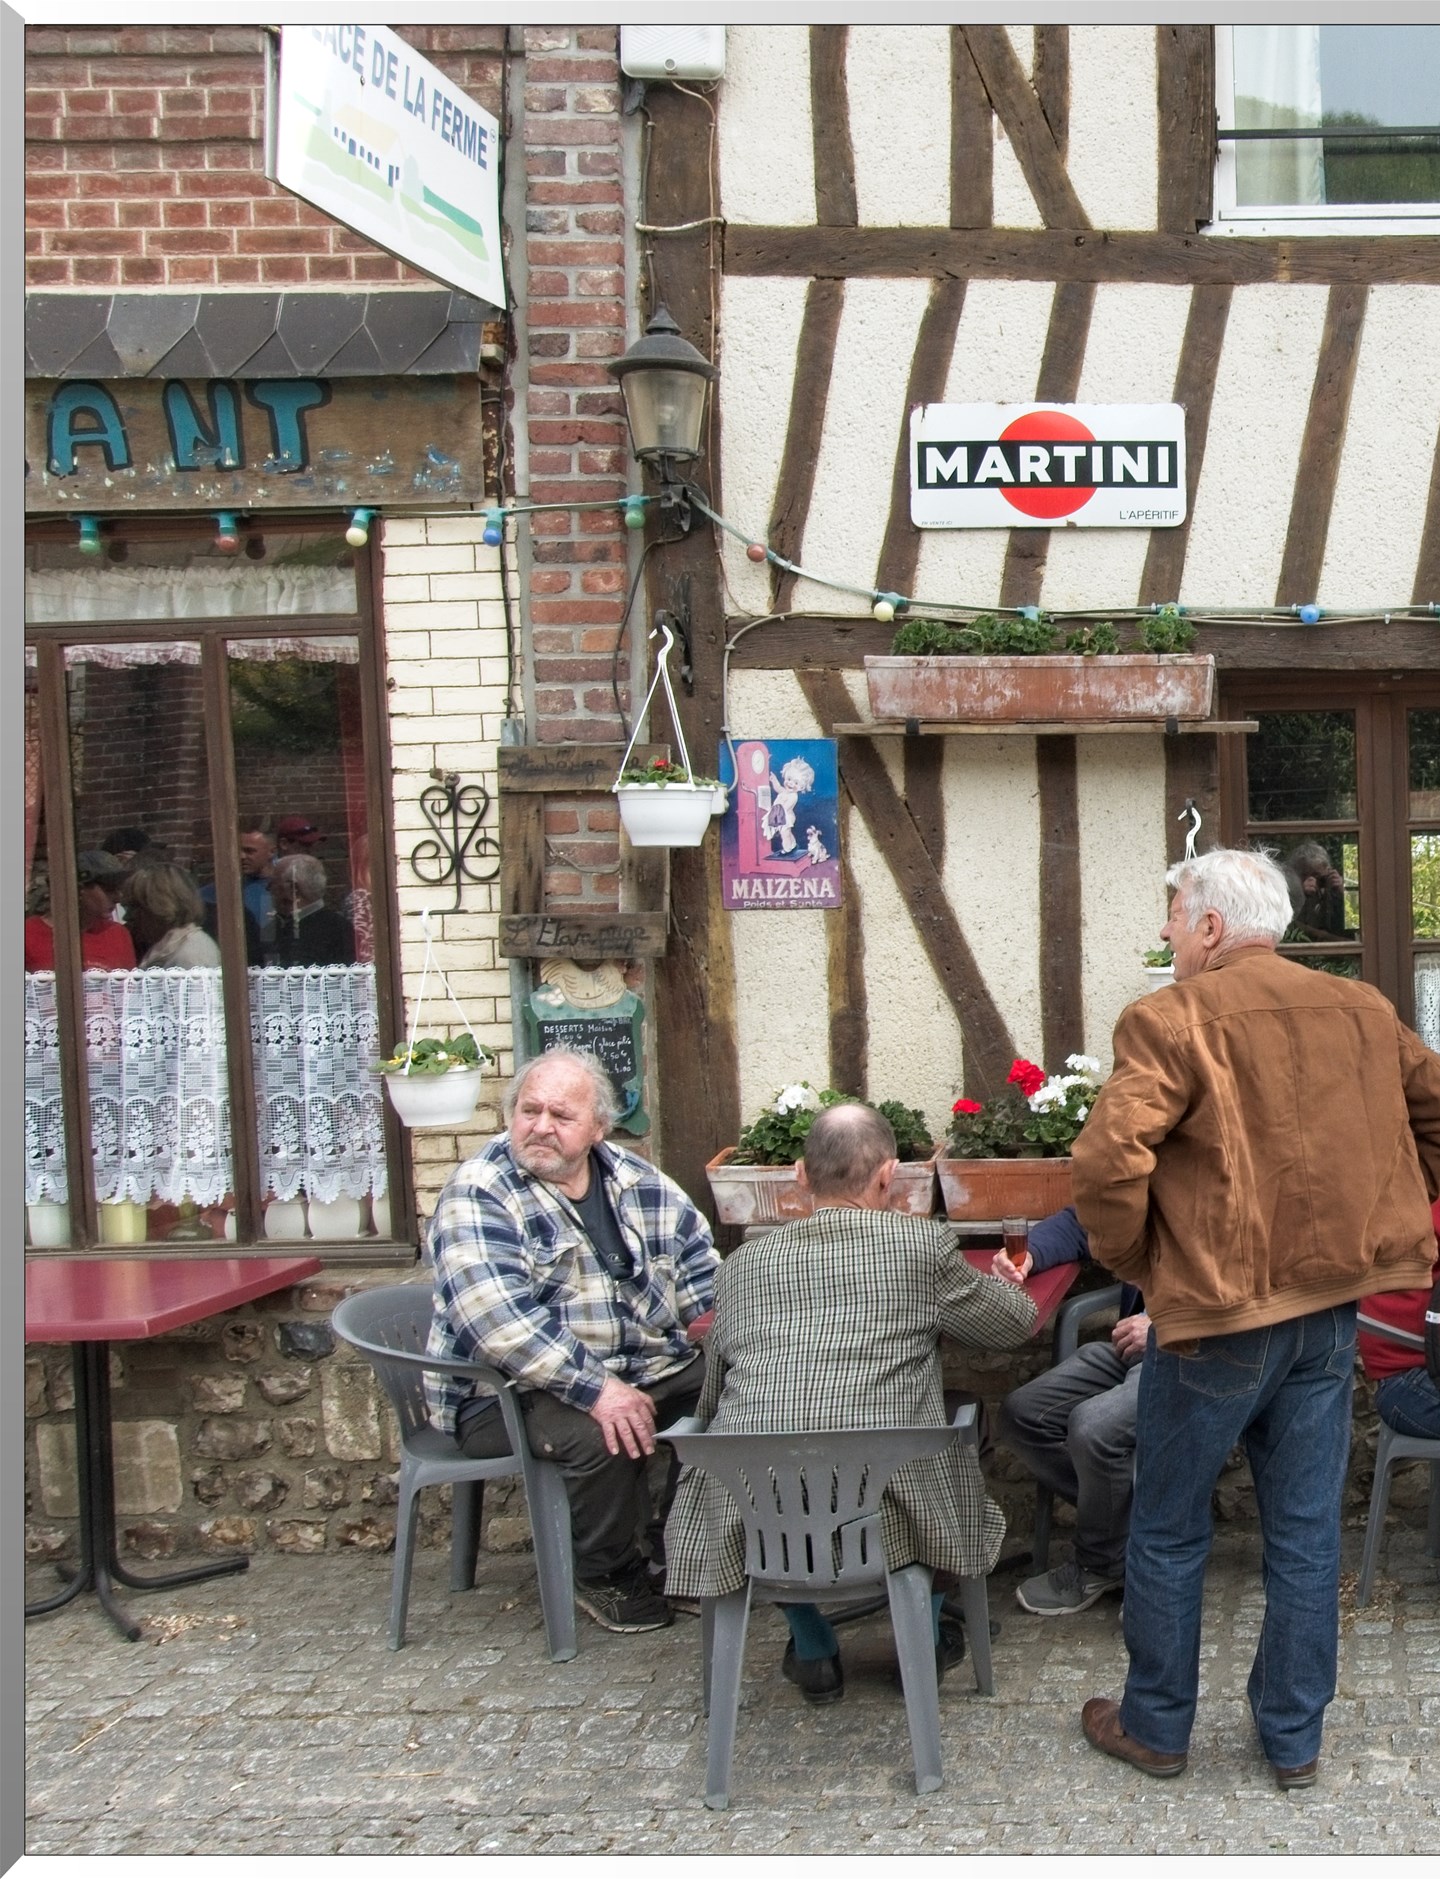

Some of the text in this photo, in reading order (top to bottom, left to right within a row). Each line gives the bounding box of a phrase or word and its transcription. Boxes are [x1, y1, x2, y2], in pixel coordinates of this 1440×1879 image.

[371, 39, 399, 101] DE
[403, 64, 426, 124] LA
[431, 88, 488, 170] FERME
[45, 378, 333, 477] ANT
[925, 445, 1170, 484] MARTINI
[1119, 508, 1179, 520] L'APÉRITIF
[731, 877, 836, 900] MAIZENA
[544, 1024, 584, 1034] DESSERTS
